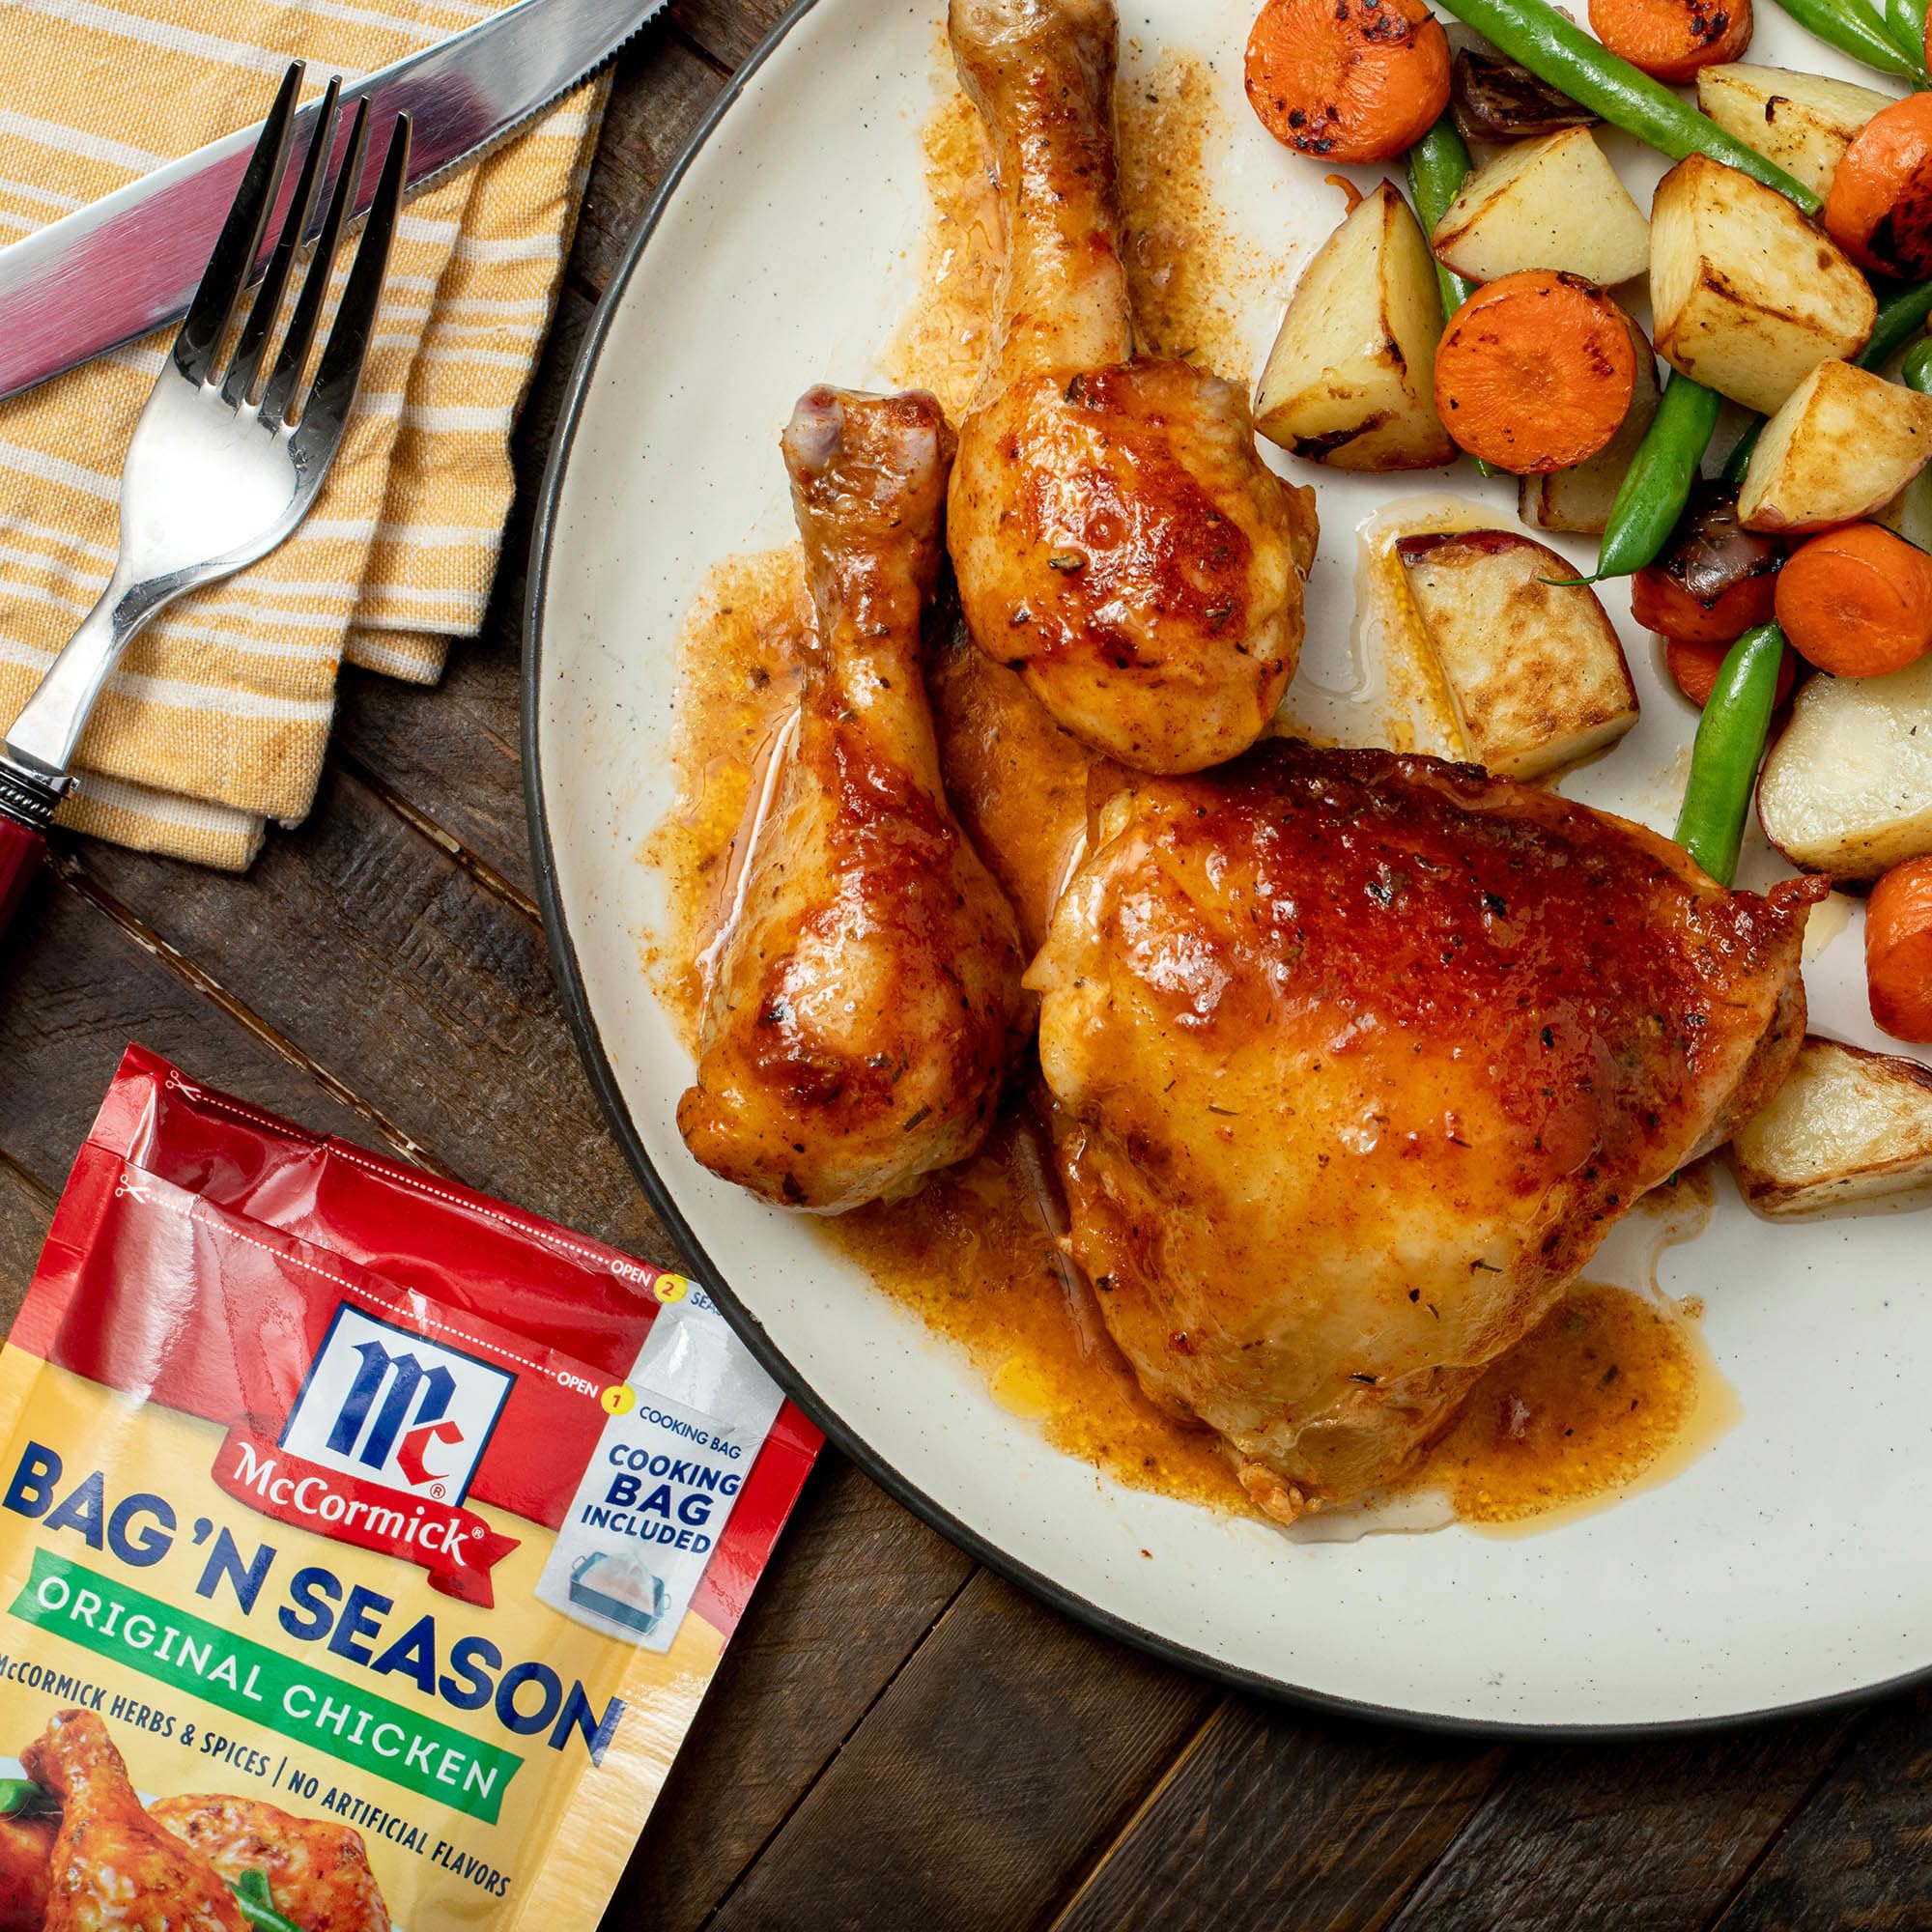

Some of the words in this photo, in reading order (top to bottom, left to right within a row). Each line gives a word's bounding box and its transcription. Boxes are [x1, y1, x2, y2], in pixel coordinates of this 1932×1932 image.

[611, 1260, 652, 1288] OPEN
[662, 1281, 674, 1296] 2
[691, 1292, 722, 1317] SEA
[557, 1372, 599, 1398] OPEN
[639, 1406, 709, 1445] COOKING
[710, 1436, 742, 1460] BAG
[234, 1441, 469, 1566] McCormick
[605, 1472, 714, 1526] BAG
[609, 1444, 741, 1495] COOKING
[581, 1504, 711, 1554] INCLUDED
[2, 1440, 177, 1567] BAG
[278, 1567, 628, 1768] SEASON
[38, 1577, 263, 1701] ORIGINAL
[283, 1684, 498, 1799] CHICKEN
[110, 1694, 177, 1737] HERBS
[180, 1723, 196, 1747] &
[200, 1732, 270, 1776] SPICES
[287, 1770, 319, 1799] NO
[321, 1787, 428, 1855] ARTIFICIAL
[431, 1840, 510, 1897] FLAVORS
